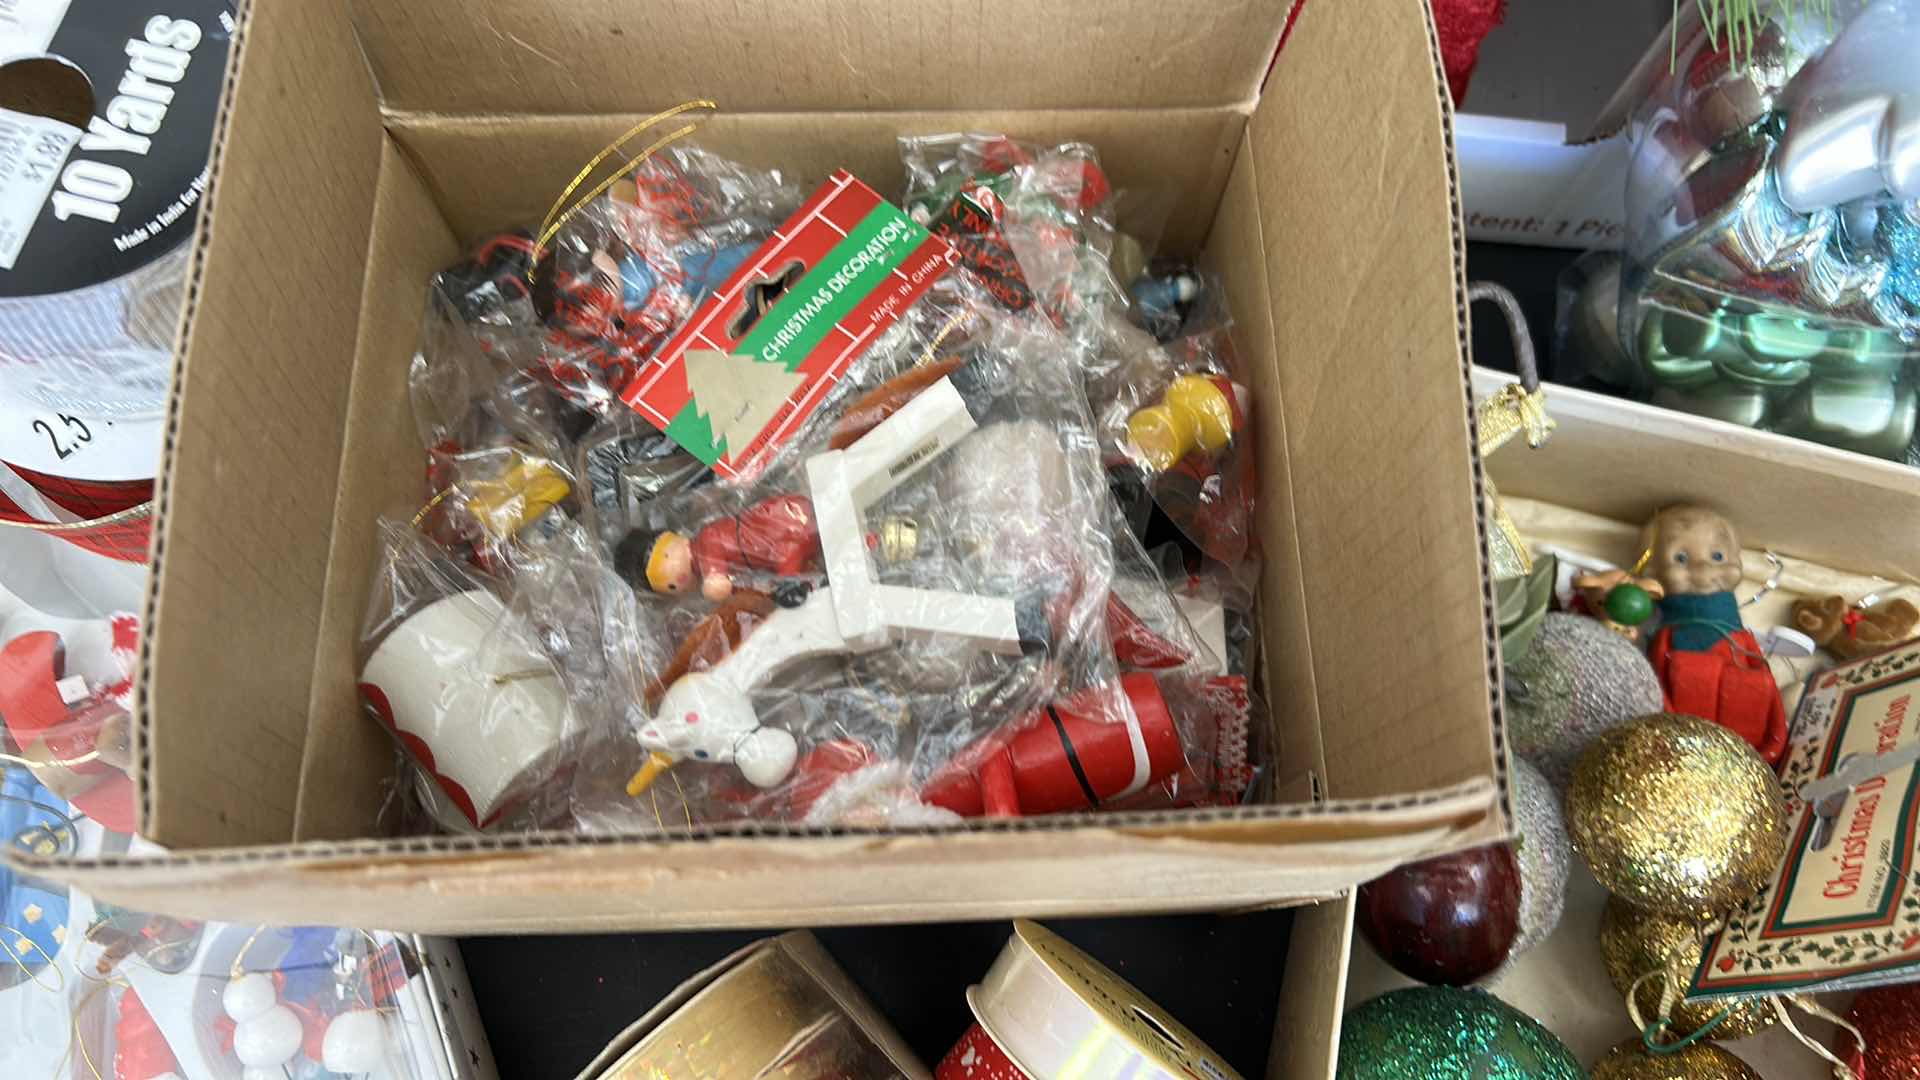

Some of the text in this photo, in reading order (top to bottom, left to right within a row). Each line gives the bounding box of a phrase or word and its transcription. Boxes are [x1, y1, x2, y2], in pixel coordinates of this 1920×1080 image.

[51, 14, 202, 224] 10 Yards
[113, 187, 199, 252] Made in India for
[762, 287, 833, 362] CHRISTMAS
[827, 216, 908, 294] DECORATION
[870, 254, 943, 324] MADE IN CHINA
[32, 411, 92, 460] 2.5
[1822, 793, 1881, 899] Christmas
